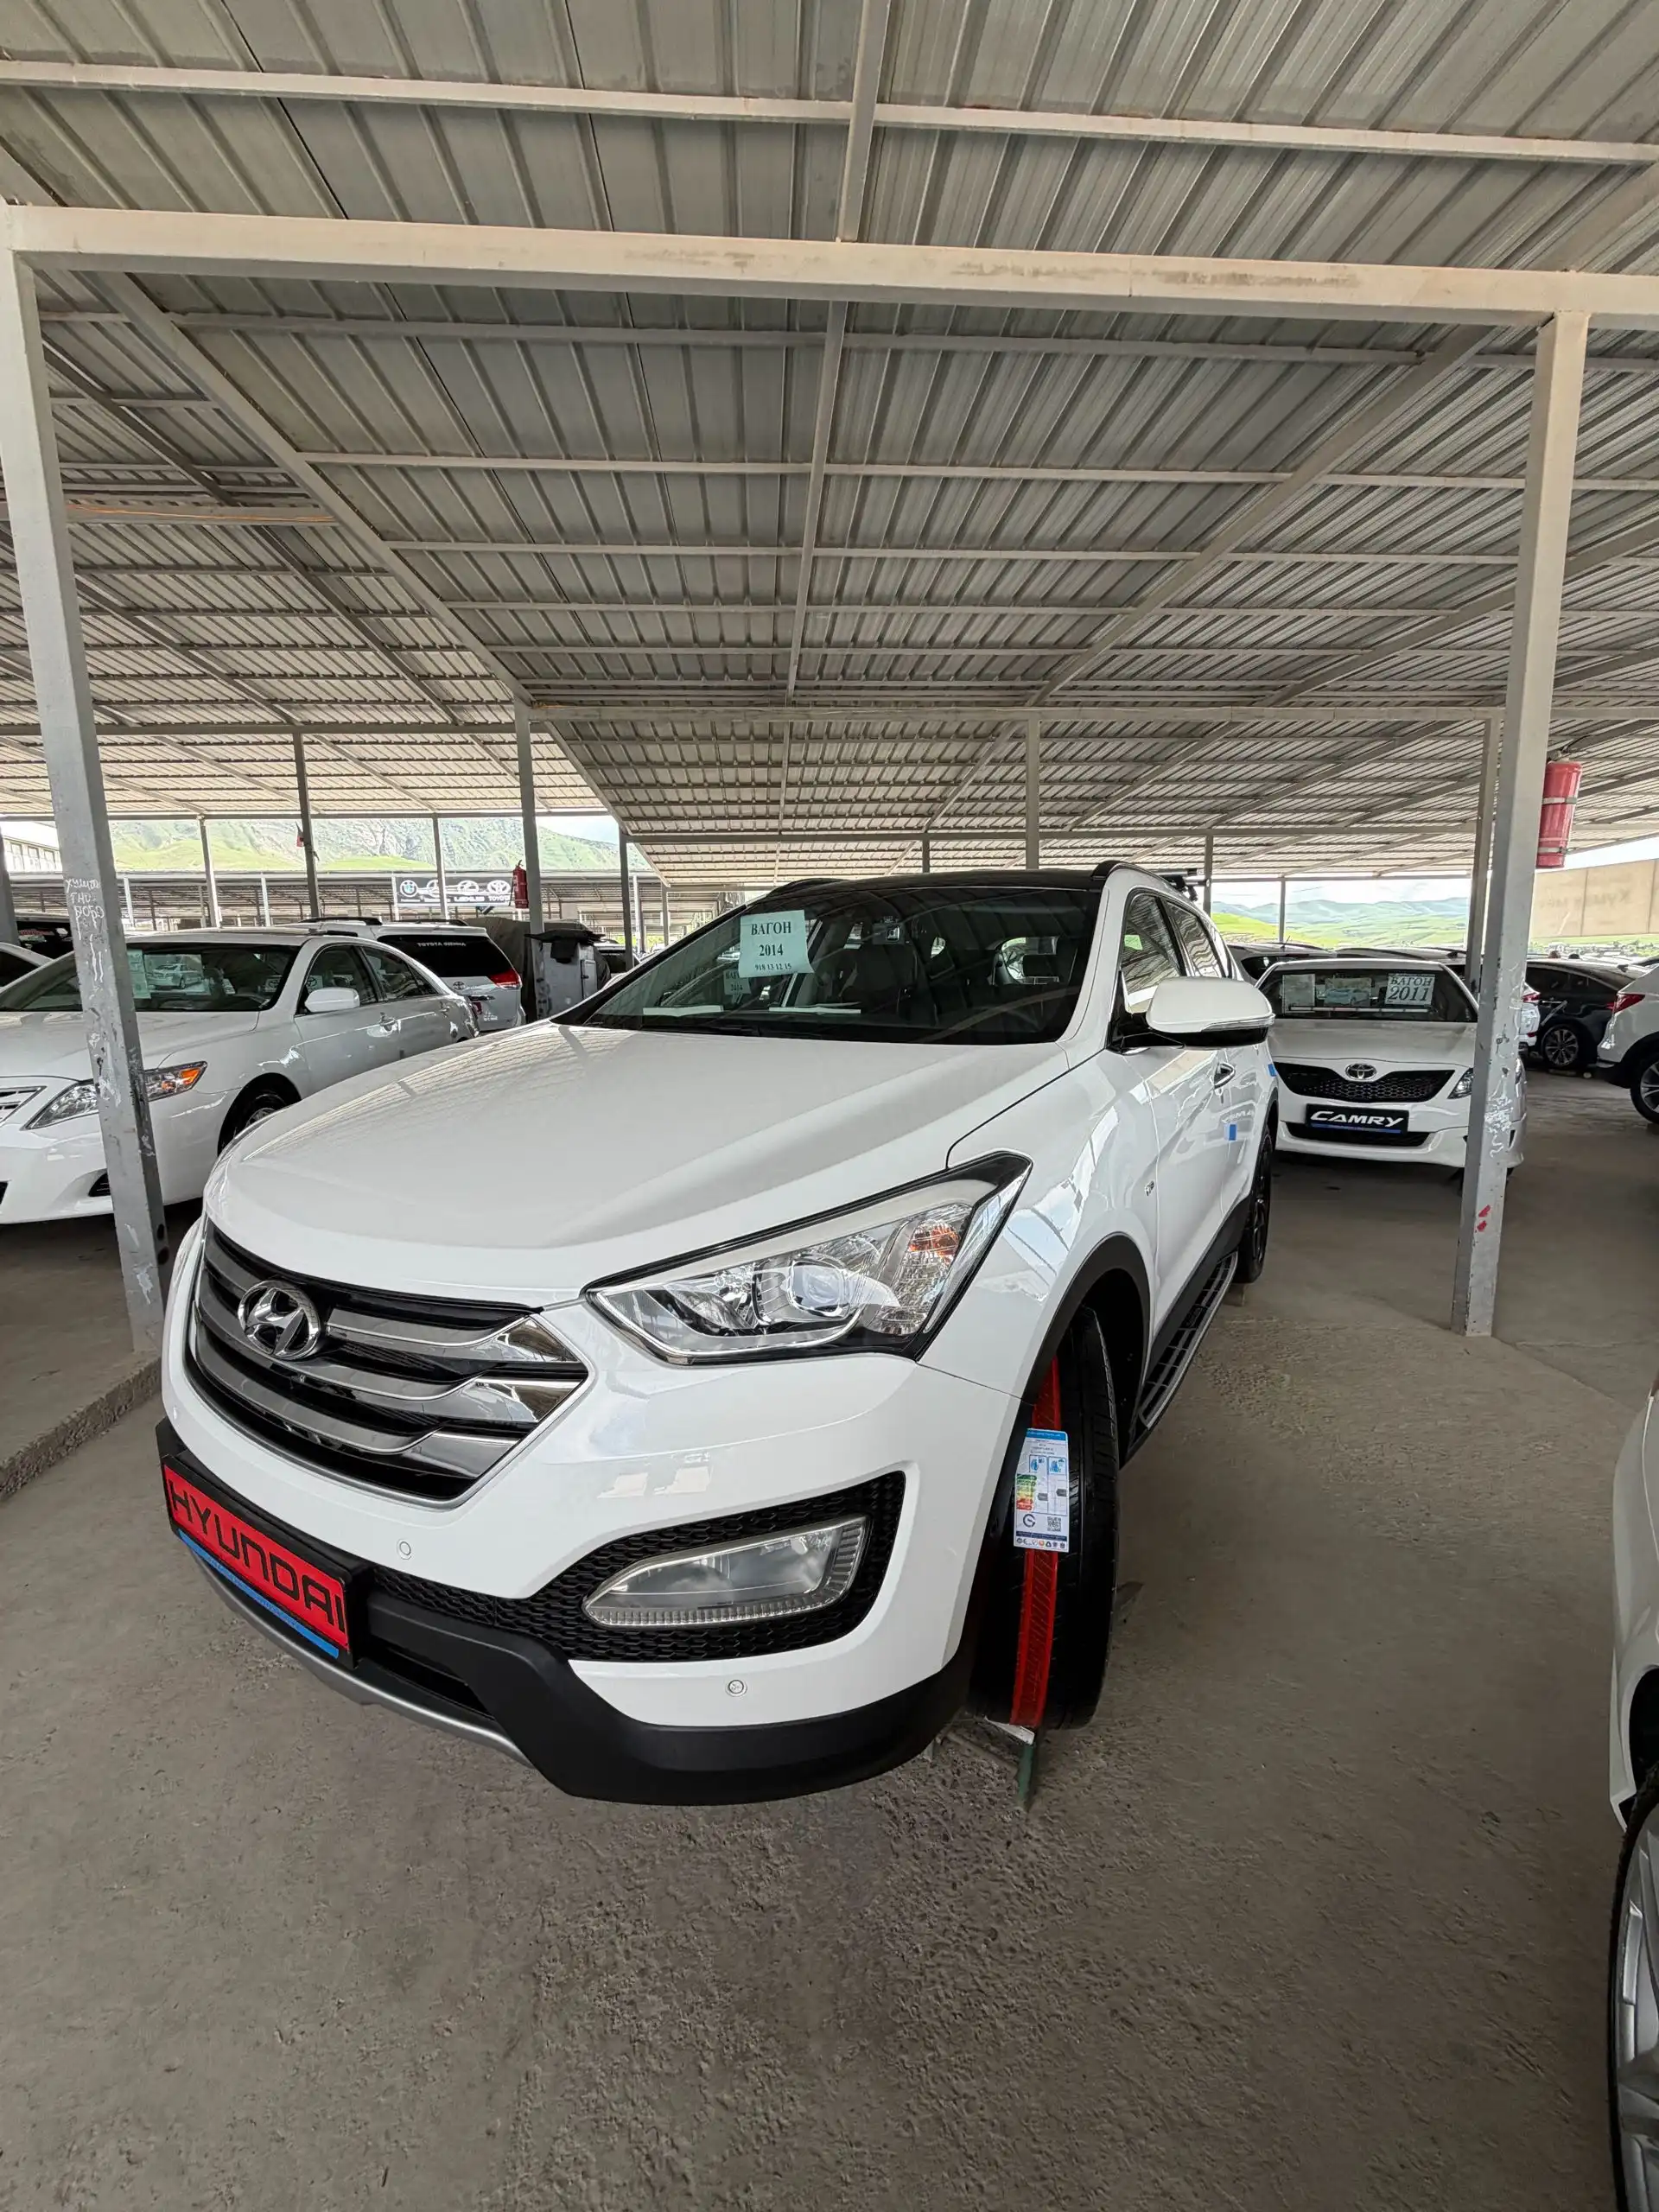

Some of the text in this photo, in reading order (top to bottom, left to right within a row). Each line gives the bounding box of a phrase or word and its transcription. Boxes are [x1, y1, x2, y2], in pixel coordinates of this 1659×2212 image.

[751, 921, 791, 935] ВАГОН
[759, 944, 784, 957] 2014
[1389, 976, 1432, 986] ВАГОН
[1388, 986, 1429, 1001] 2011
[1310, 1110, 1404, 1128] CAMRY
[168, 1479, 346, 1632] HYUNDAI
